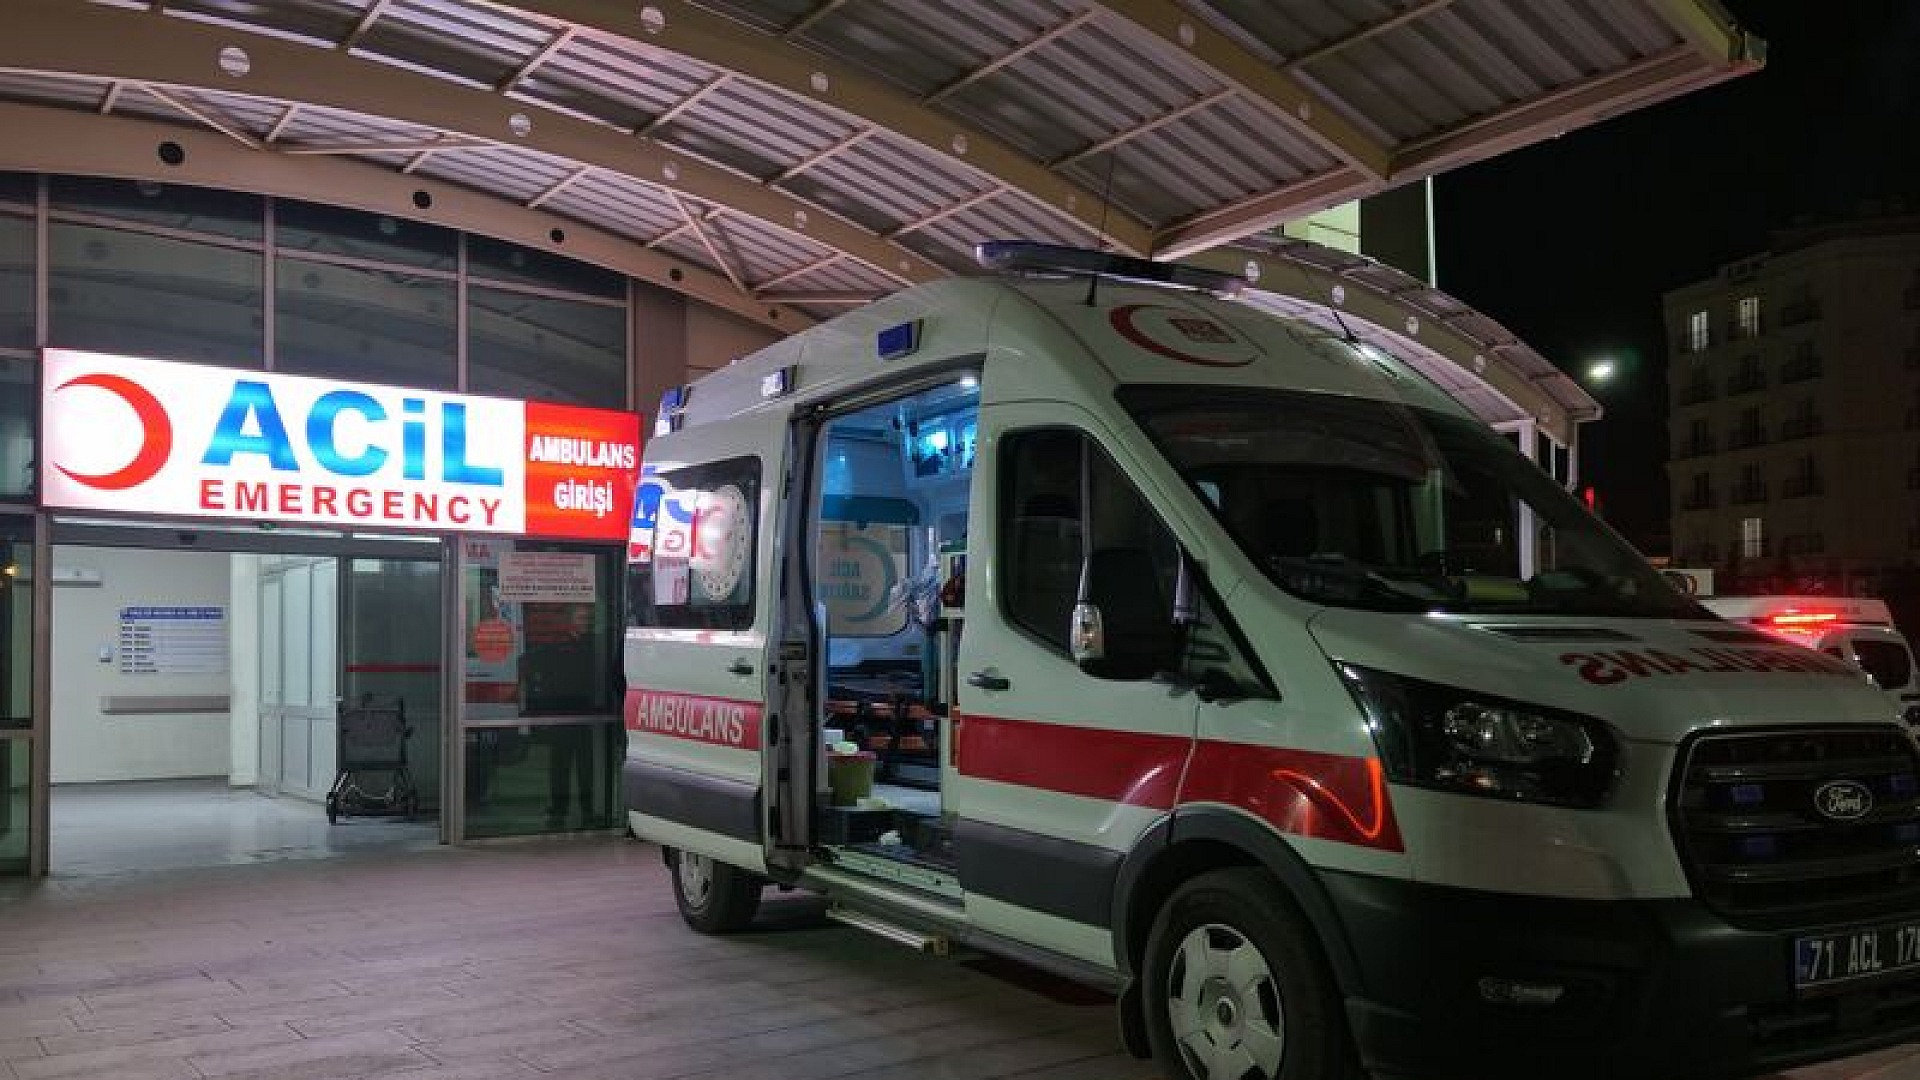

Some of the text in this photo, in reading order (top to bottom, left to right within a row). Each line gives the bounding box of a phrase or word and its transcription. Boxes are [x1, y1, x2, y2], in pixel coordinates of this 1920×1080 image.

[529, 434, 635, 469] AMBULANS
[200, 479, 502, 527] EMERGENCY
[635, 694, 745, 744] AMBULANS
[1809, 940, 1835, 980] 71
[1847, 929, 1883, 974] ACL
